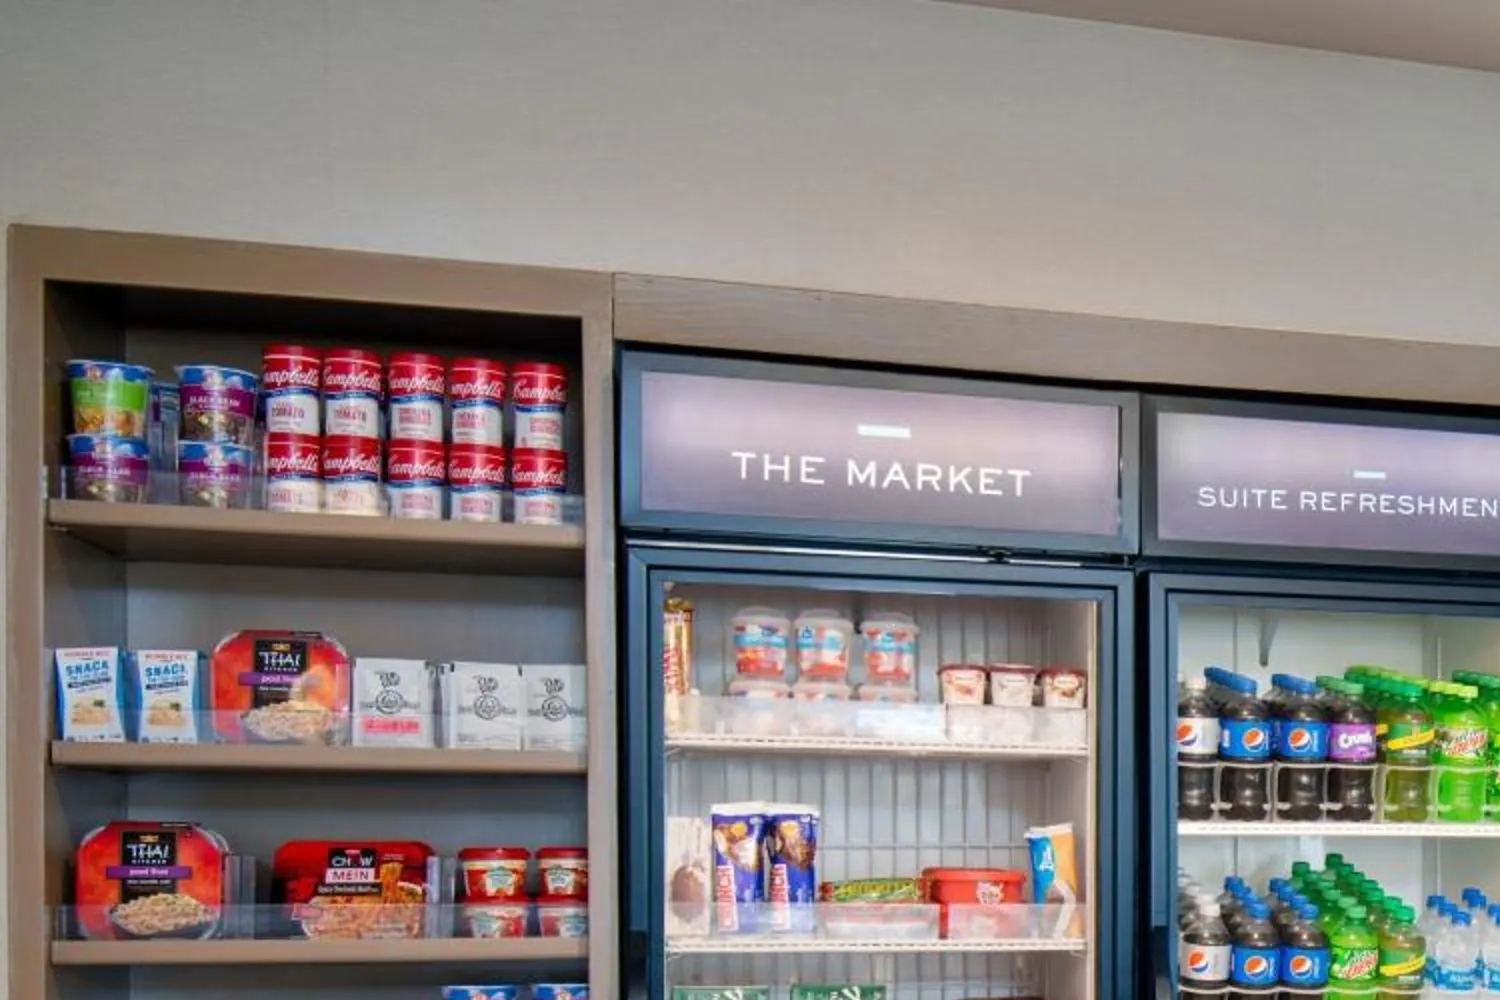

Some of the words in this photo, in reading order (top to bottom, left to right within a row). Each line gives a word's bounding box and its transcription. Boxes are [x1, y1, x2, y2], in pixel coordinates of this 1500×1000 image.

[731, 451, 826, 485] THE
[846, 457, 1032, 498] MARKET
[1198, 486, 1289, 511] SUITE
[258, 651, 301, 666] THAI
[126, 843, 170, 858] THAI
[331, 855, 374, 868] CHW
[331, 869, 370, 881] MEIN
